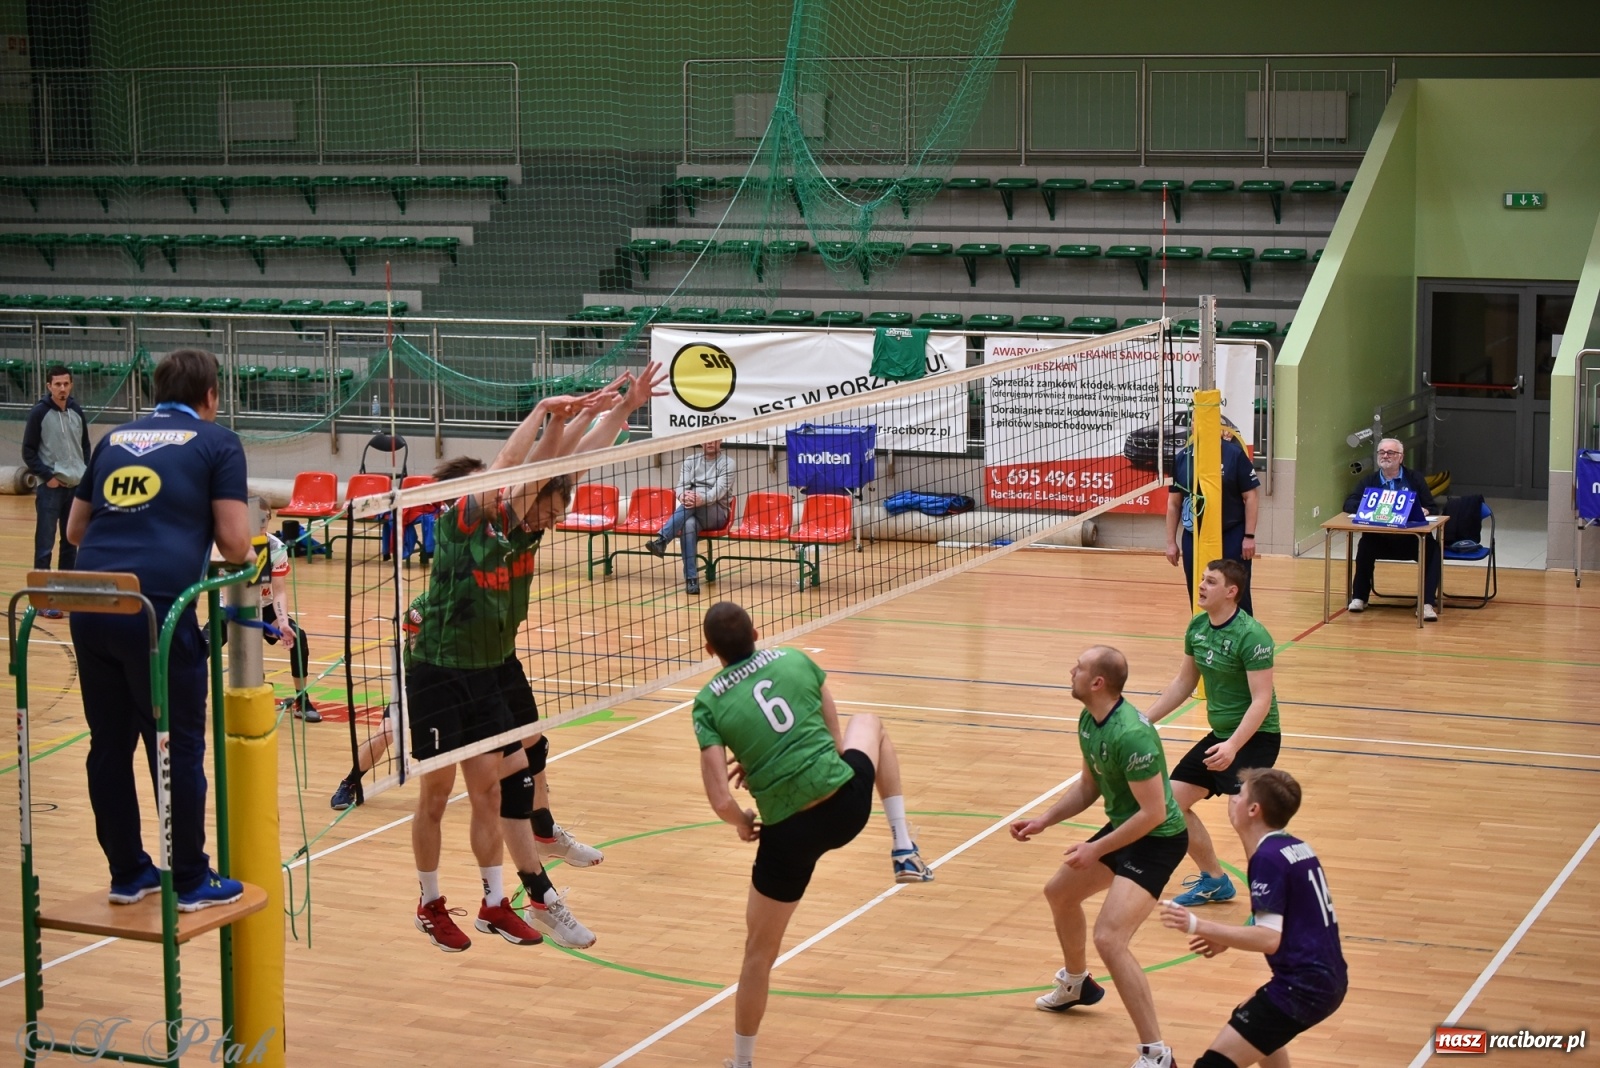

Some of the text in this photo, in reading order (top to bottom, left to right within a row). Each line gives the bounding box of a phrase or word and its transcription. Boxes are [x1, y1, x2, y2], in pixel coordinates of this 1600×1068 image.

[992, 404, 1043, 415] Dorabianie
[1045, 406, 1065, 416] oraz
[1066, 406, 1119, 418] kodowanie
[996, 418, 1032, 429] pilotów
[1033, 420, 1113, 433] samochodowych
[797, 451, 851, 465] molten
[111, 476, 151, 497] HK
[1007, 468, 1114, 490] 695 496 555
[990, 489, 1032, 500] Racibórz
[1135, 495, 1150, 506] 45
[1367, 491, 1379, 509] 6
[1395, 494, 1407, 511] 9
[752, 678, 795, 734] 6
